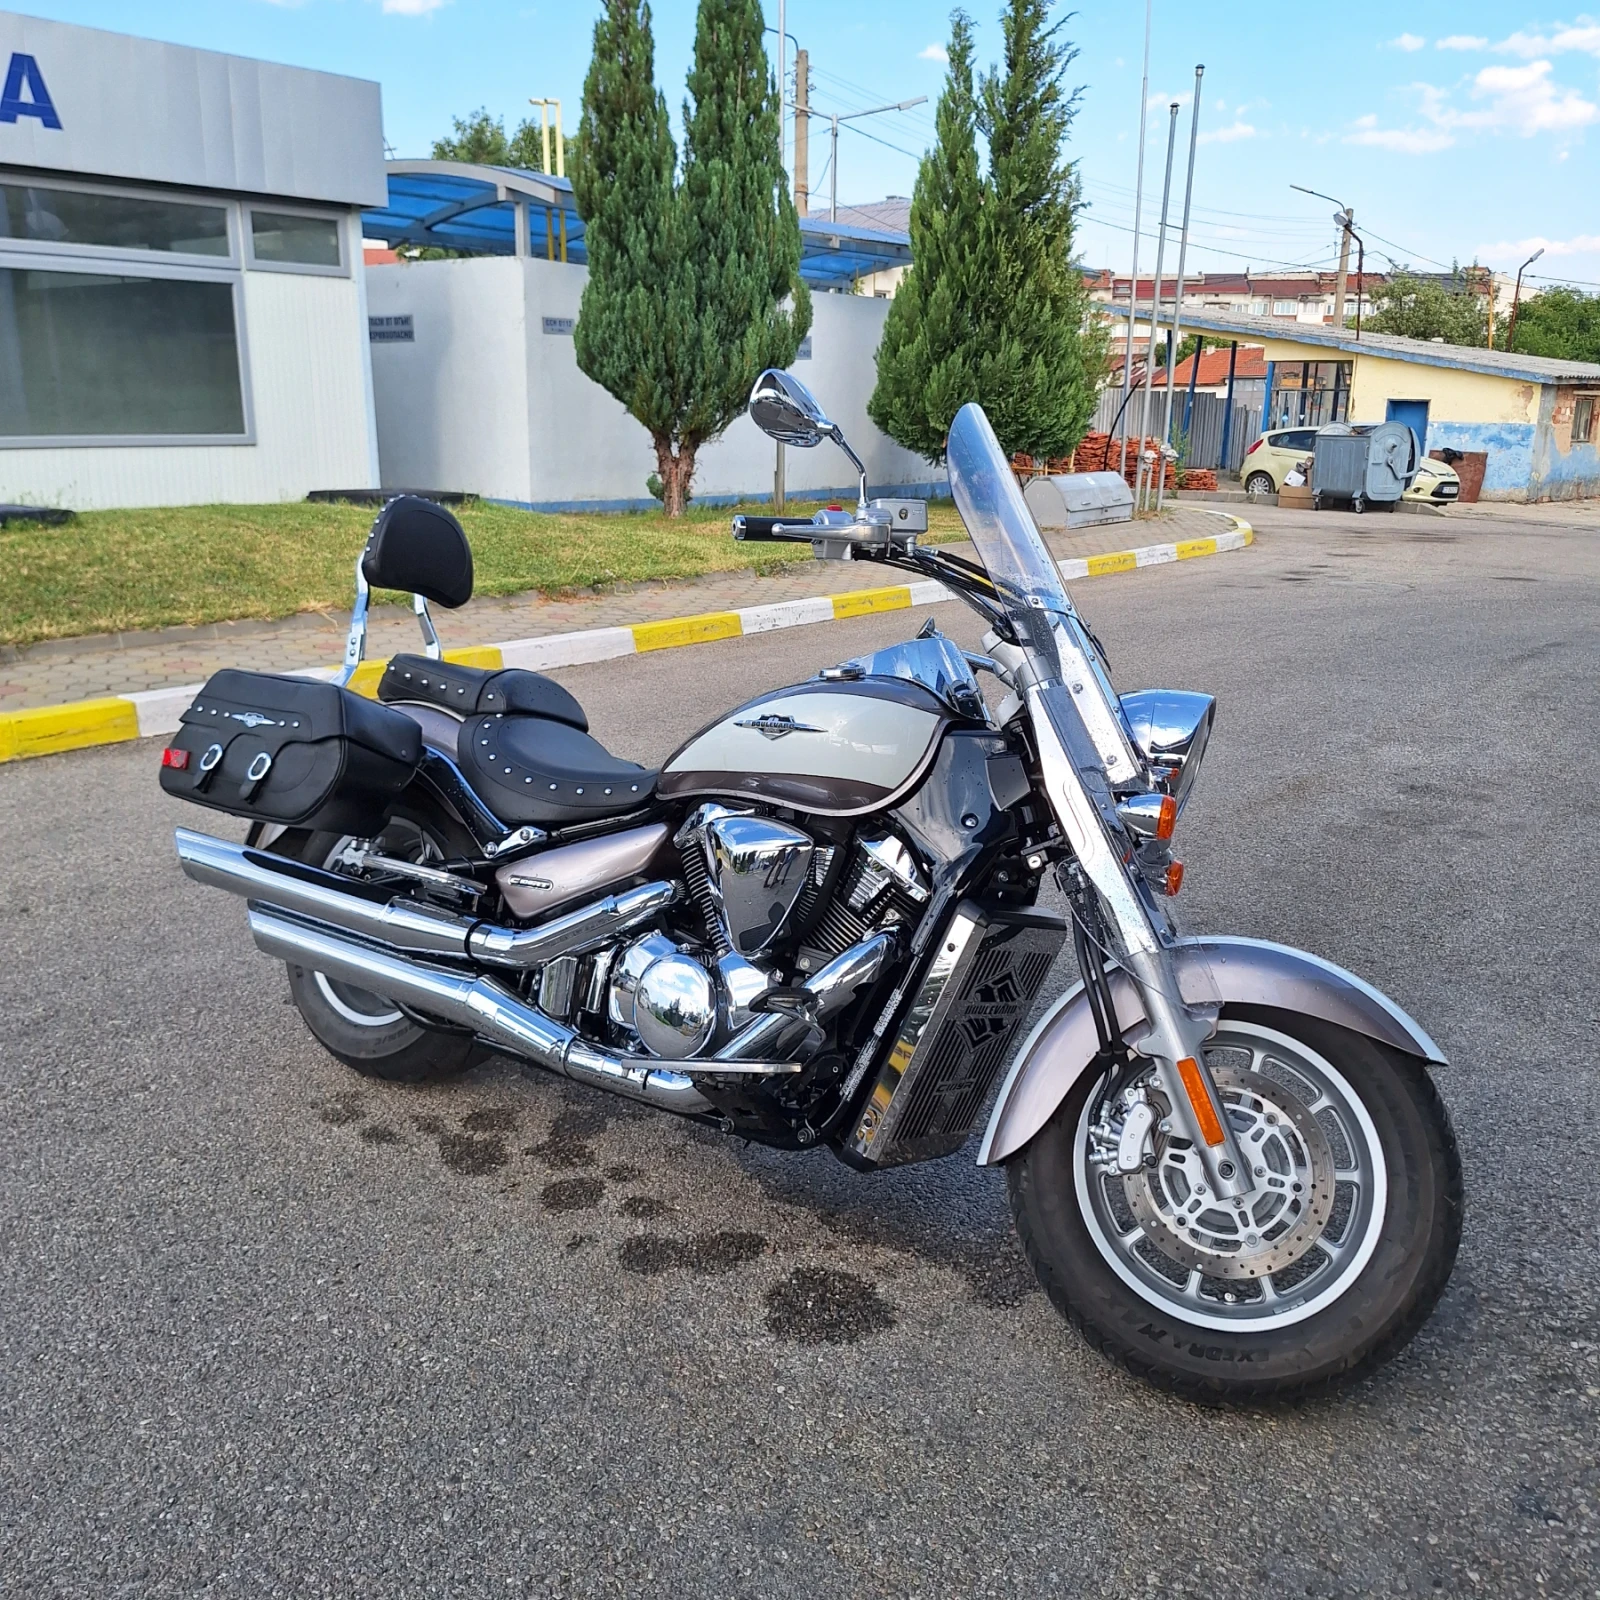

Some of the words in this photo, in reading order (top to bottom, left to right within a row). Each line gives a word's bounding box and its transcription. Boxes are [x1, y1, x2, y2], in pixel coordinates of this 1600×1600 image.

[751, 721, 796, 730] BOULEVARD
[964, 1004, 1018, 1015] BOULEVARD
[1173, 1335, 1270, 1362] EXEDRA
